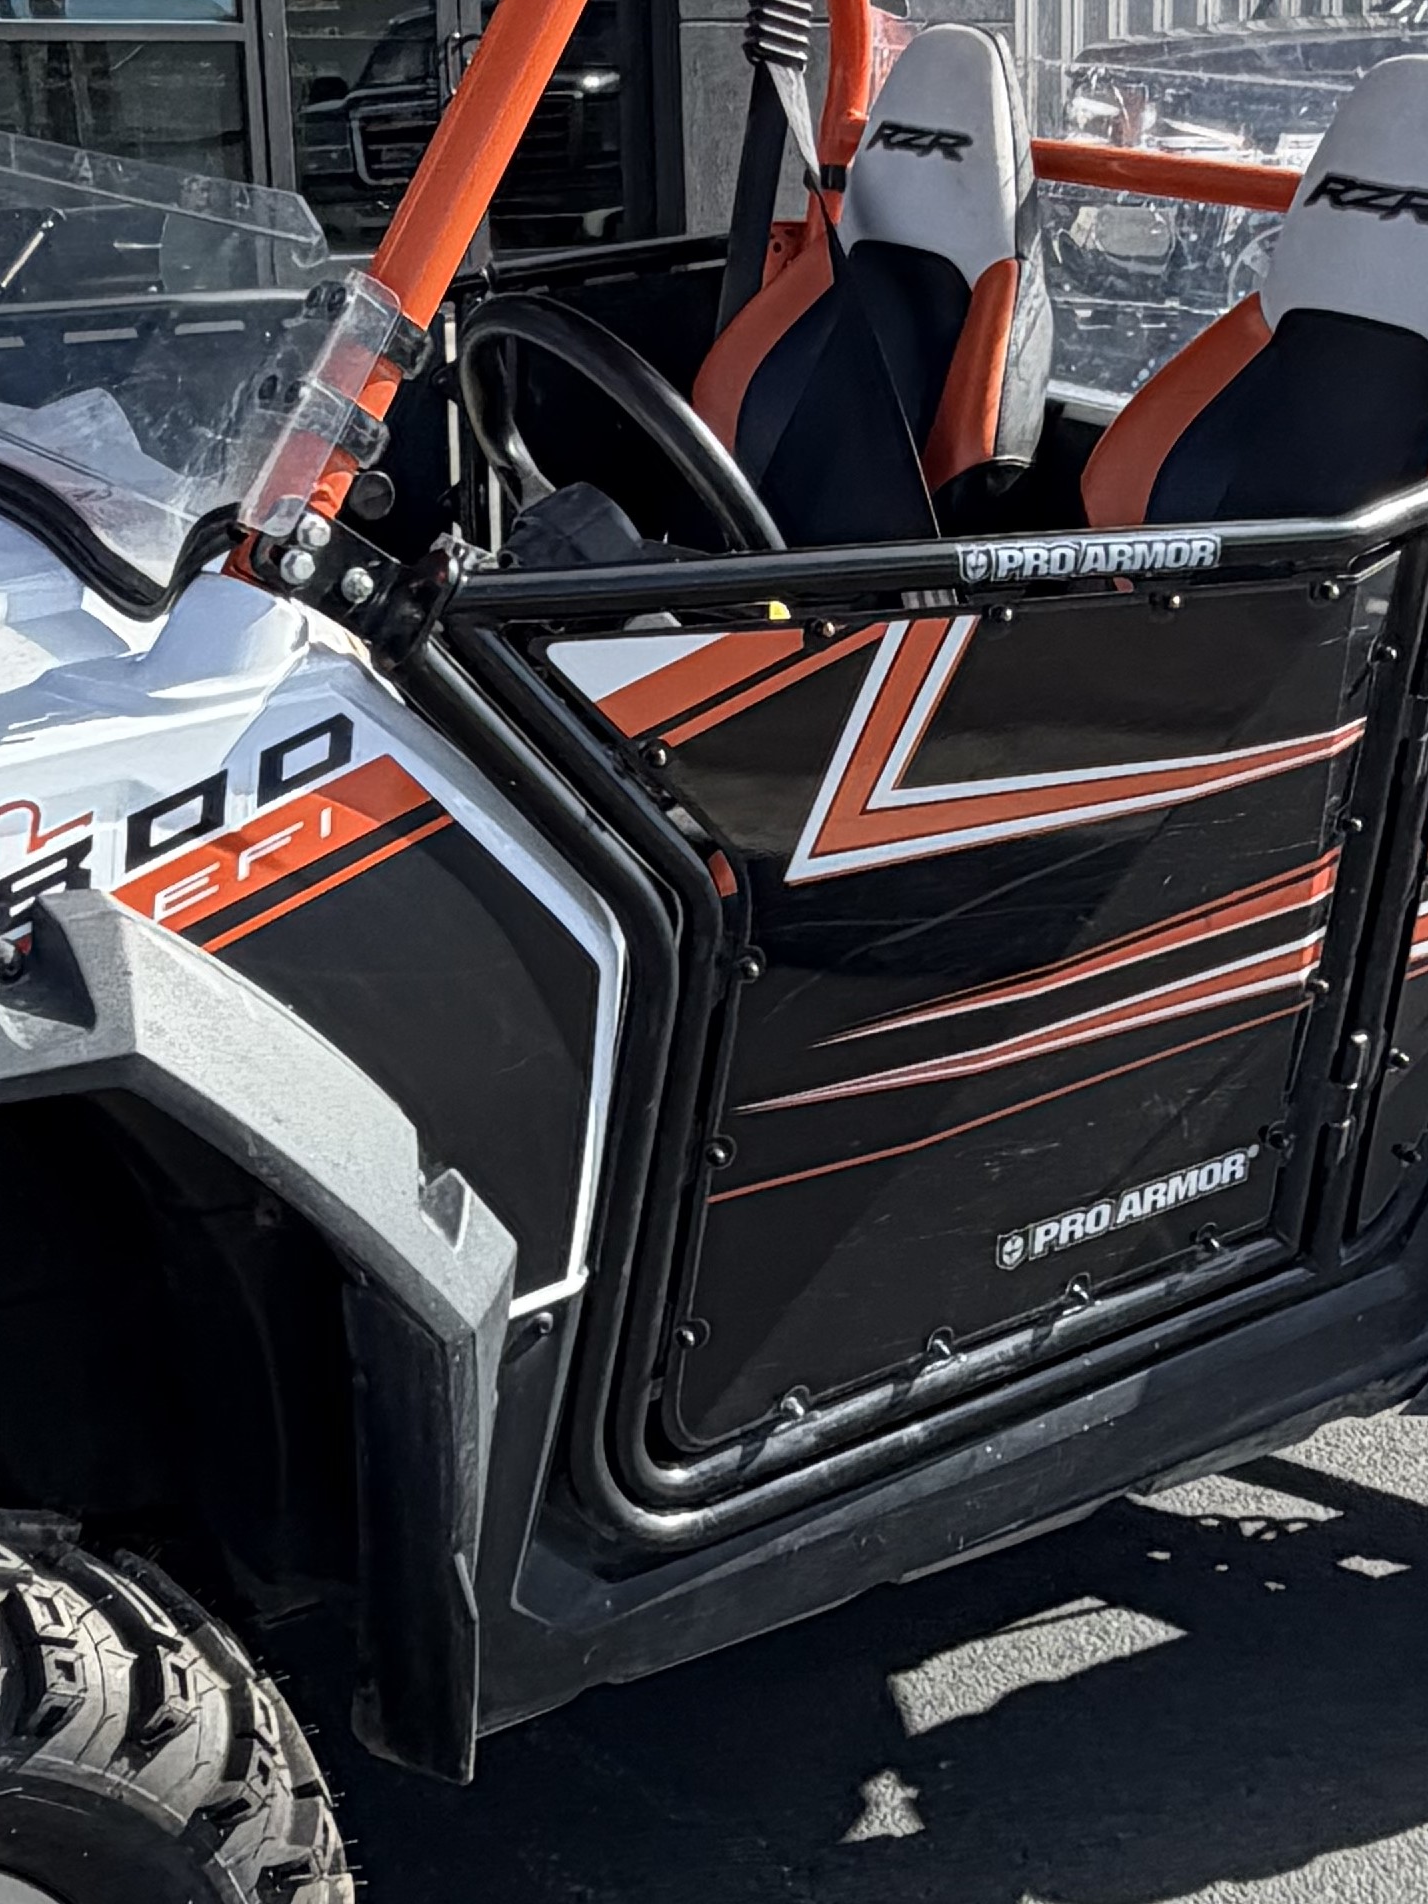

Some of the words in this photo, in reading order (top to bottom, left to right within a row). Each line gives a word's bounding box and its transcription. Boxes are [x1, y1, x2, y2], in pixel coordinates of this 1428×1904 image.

[865, 120, 974, 164] RZR
[997, 546, 1077, 579] PRO
[1079, 540, 1215, 574] ARMOR
[152, 805, 334, 925] EFI
[1033, 1203, 1113, 1255] PRO
[1116, 1152, 1248, 1224] ARMOR
